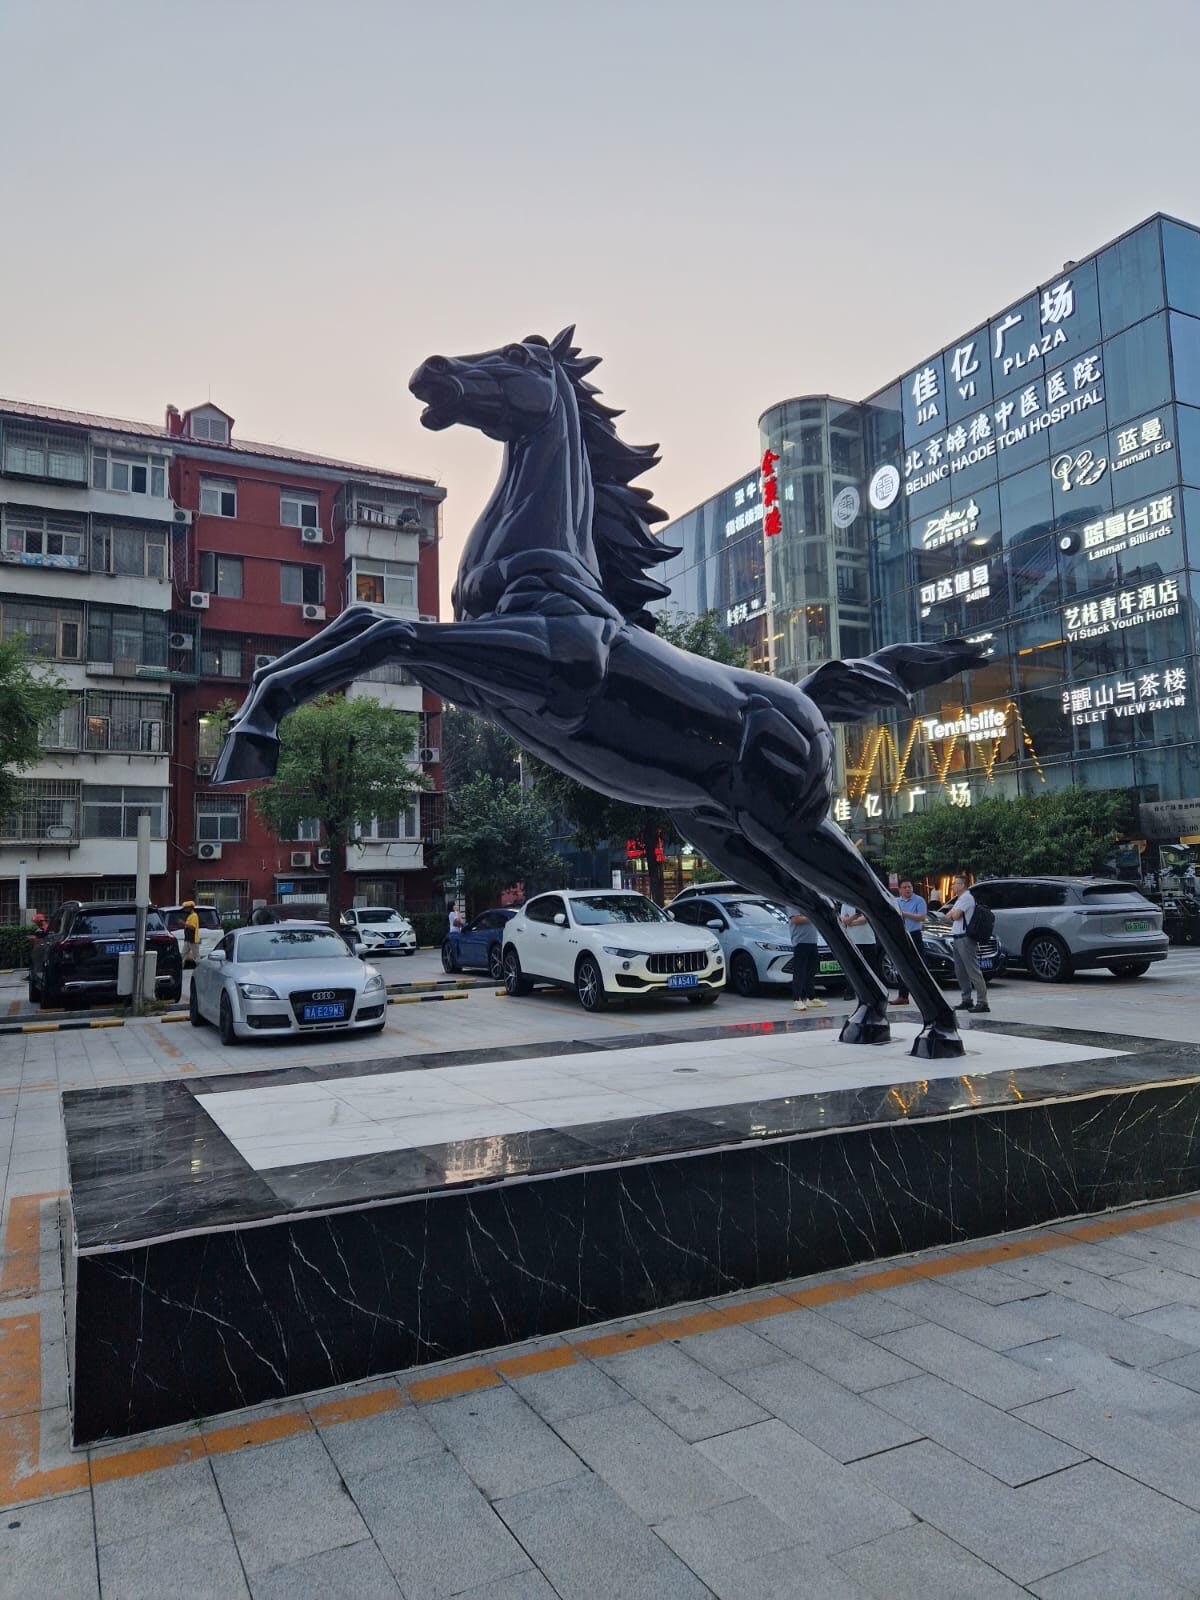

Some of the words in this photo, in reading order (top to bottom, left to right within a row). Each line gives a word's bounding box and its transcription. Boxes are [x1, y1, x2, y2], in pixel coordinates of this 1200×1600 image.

[912, 280, 1074, 406] 佳亿广场
[917, 403, 939, 425] JIA
[958, 381, 976, 400] YI
[1003, 328, 1068, 375] PLAZA
[905, 464, 949, 496] BEIJING
[951, 440, 996, 473] HAODE
[997, 426, 1028, 449] TCM
[1030, 389, 1103, 434] HOSPITAL
[1111, 448, 1151, 472] Lanman
[1154, 440, 1173, 456] Era
[1117, 417, 1163, 456] 蓝曼
[1083, 495, 1176, 550] 蓝曼台球
[1088, 539, 1127, 561] Lanman
[1129, 524, 1172, 547] Billiards
[1065, 578, 1179, 631] 艺栈青年酒店
[1066, 630, 1078, 643] Yi
[1079, 623, 1110, 640] Stack
[1112, 614, 1144, 631] Youth
[1146, 604, 1179, 622] Hotel
[1072, 710, 1107, 726] ISLET
[1114, 702, 1145, 718] VIEW
[833, 781, 972, 821] 佳亿广场
